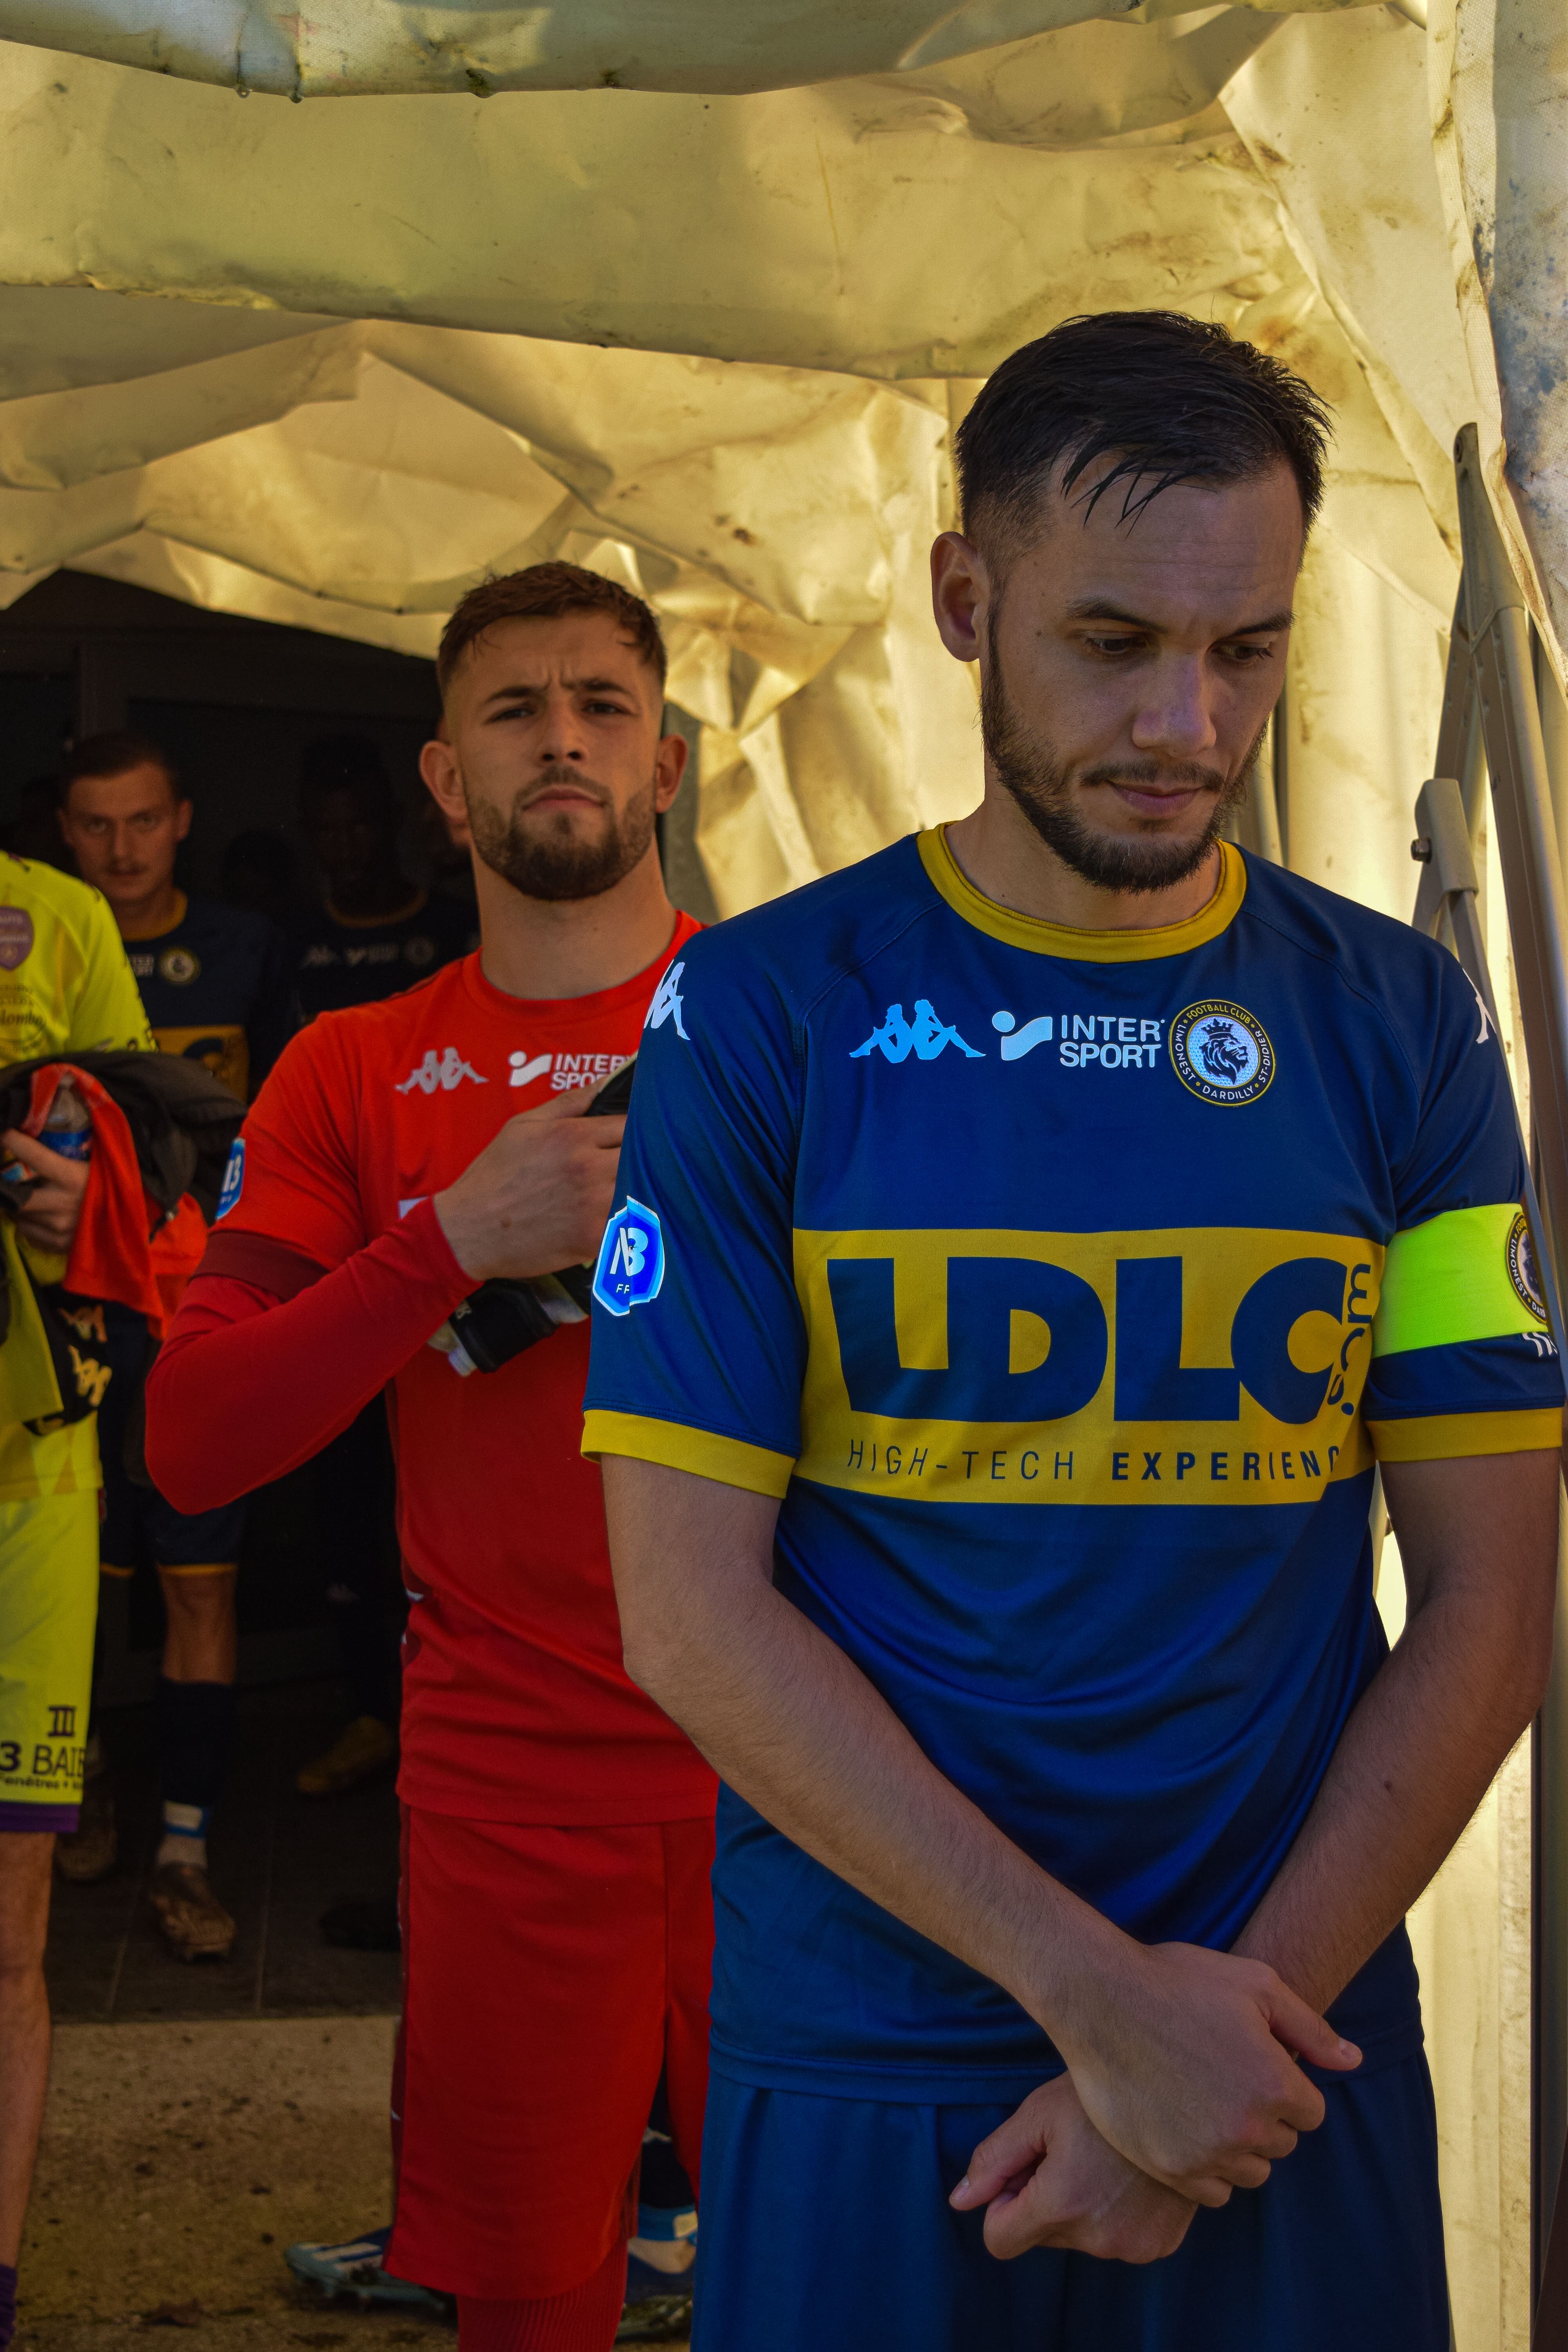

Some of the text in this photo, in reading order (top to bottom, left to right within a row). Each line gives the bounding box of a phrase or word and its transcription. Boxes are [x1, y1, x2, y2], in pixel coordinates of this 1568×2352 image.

[1062, 1014, 1160, 1042] INTER
[1186, 1004, 1250, 1024] FOOTBALL CLUB
[1060, 1042, 1162, 1068] SPORT
[1175, 1024, 1196, 1080] LIMONEST
[1256, 1030, 1271, 1083] ST-DIDIER
[550, 1071, 608, 1091] SPO
[1202, 1085, 1253, 1100] DARDILLY
[1510, 1238, 1527, 1297] LIMONEST
[827, 1256, 1348, 1425] LDLC
[848, 1439, 1075, 1481] HIGH-TECH
